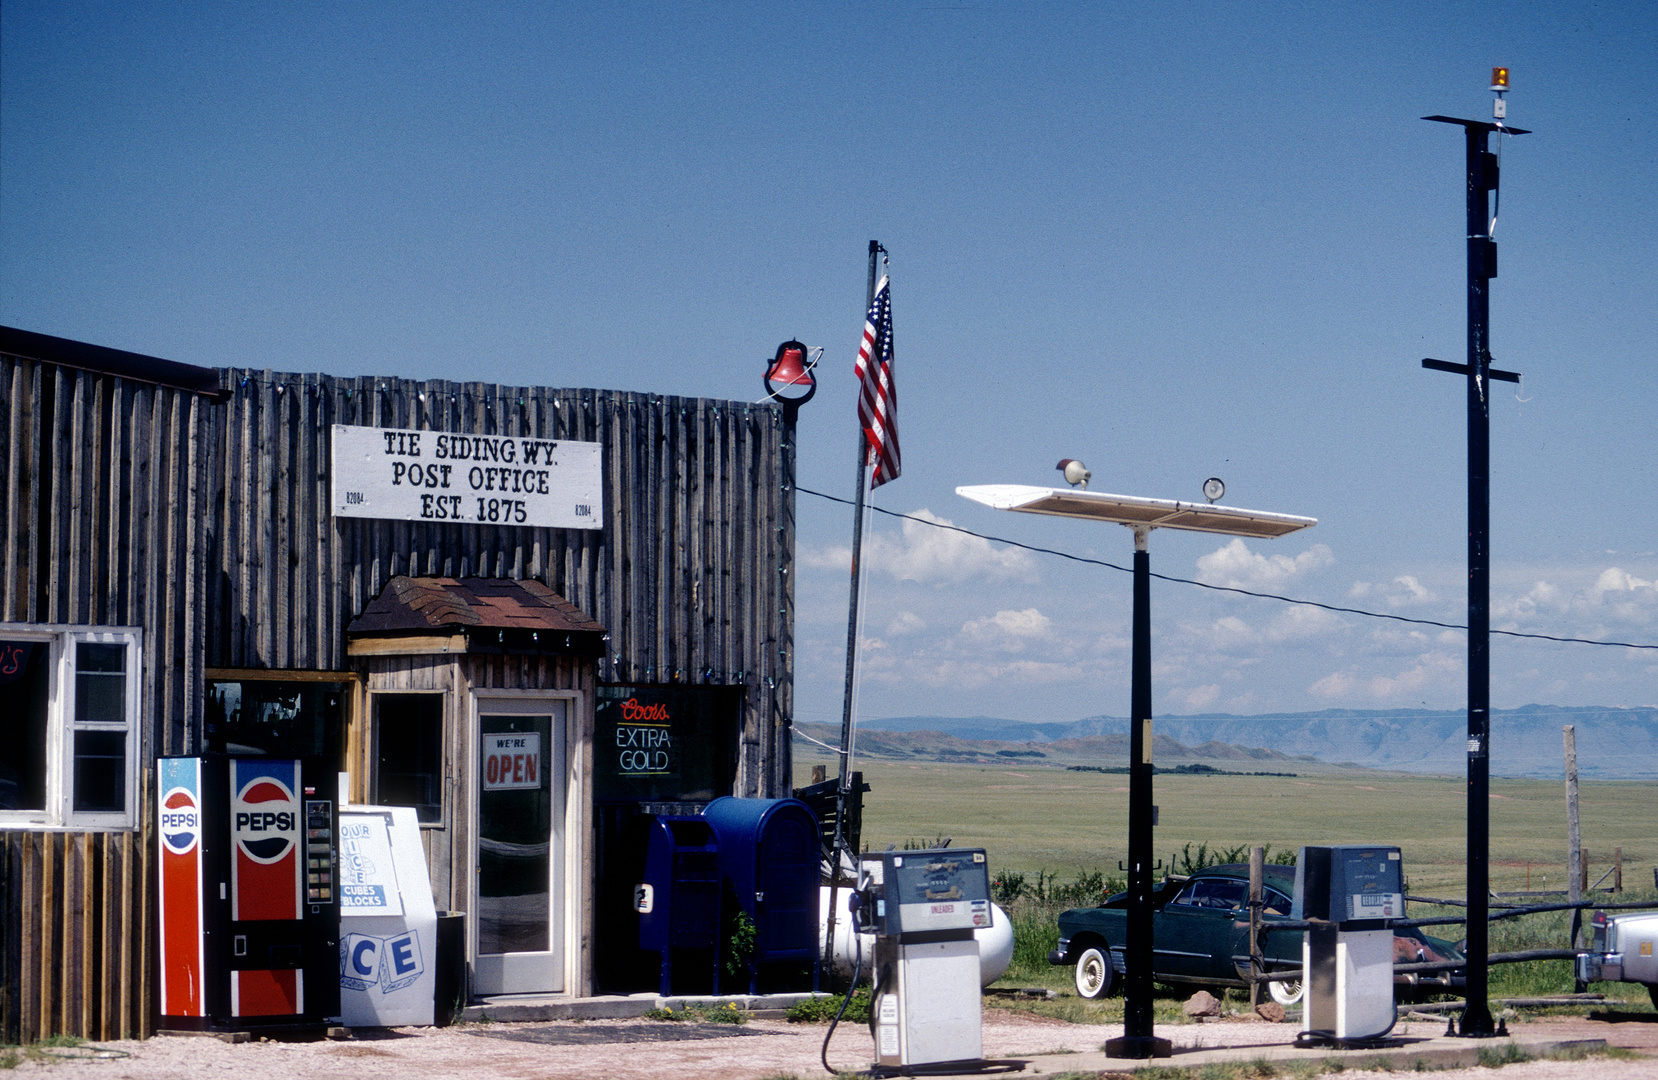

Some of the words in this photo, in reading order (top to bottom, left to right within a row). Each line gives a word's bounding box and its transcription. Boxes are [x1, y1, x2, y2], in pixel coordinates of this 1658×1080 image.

[384, 432, 421, 456] TIE
[392, 462, 452, 488] POST
[469, 466, 550, 495] OFFICE
[420, 494, 464, 519] EST.
[476, 497, 527, 523] 1875
[620, 699, 670, 720] Coors
[496, 739, 526, 748] WE'RE
[616, 728, 671, 748] EXTRA
[487, 754, 537, 784] OPEN
[620, 750, 668, 770] GOLD
[162, 813, 198, 828] PEPSI
[236, 812, 295, 831] PEPSI
[344, 886, 375, 895] CUBES
[342, 896, 381, 906] BLOCKS
